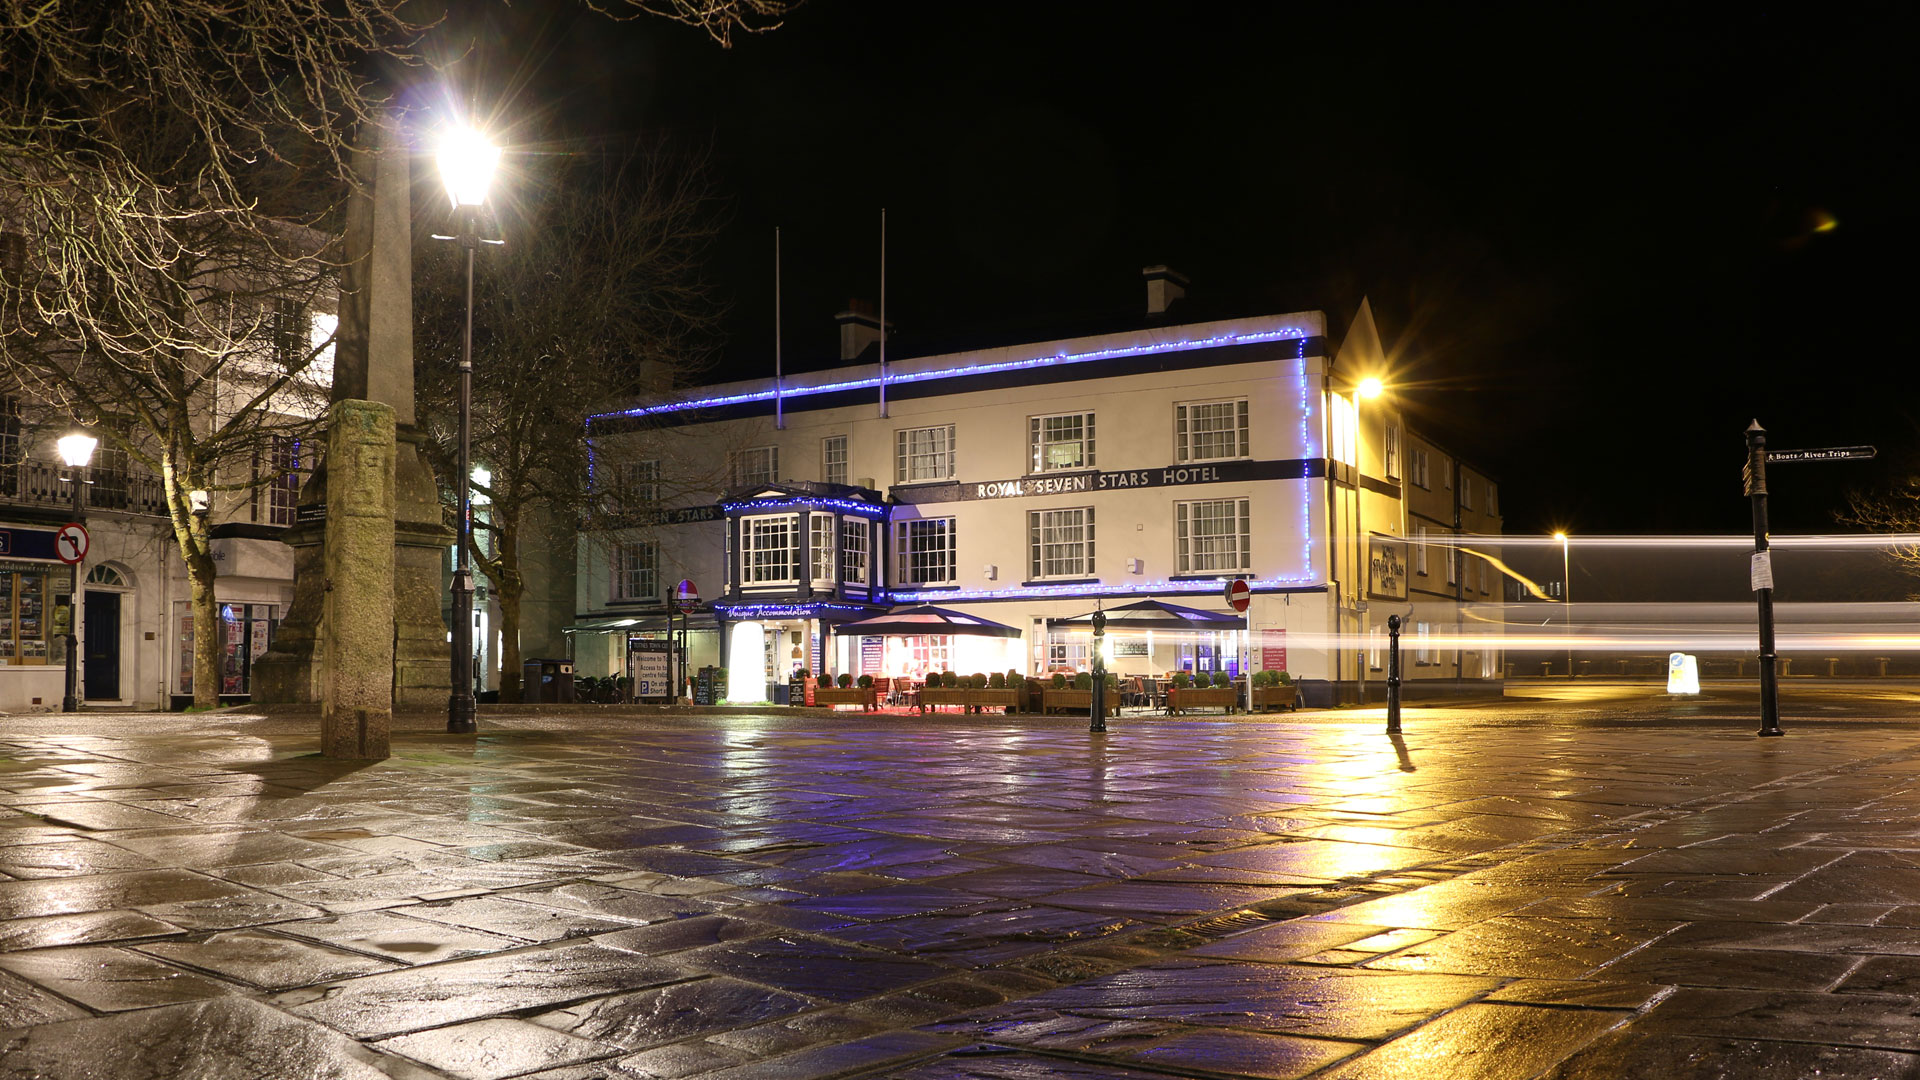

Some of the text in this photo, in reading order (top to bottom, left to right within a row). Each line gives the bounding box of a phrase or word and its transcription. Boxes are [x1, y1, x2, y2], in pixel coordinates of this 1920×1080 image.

[1827, 450, 1851, 458] Trips
[978, 467, 1220, 498] ROYAL SEVEN STARS HOTEL
[678, 508, 714, 522] STARS
[727, 603, 812, 620] Unique Accommodation
[642, 682, 647, 693] P
